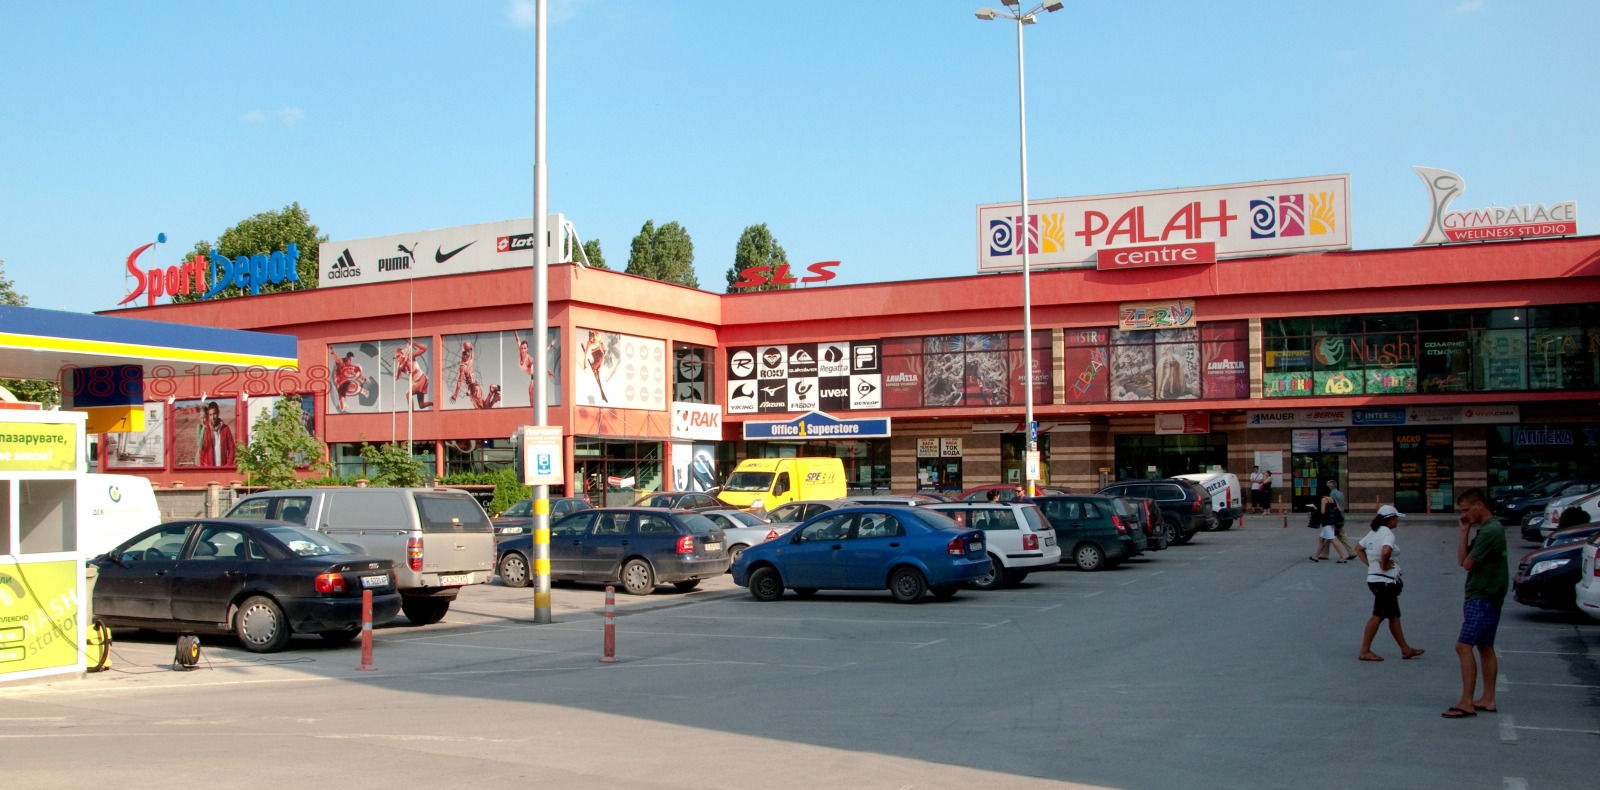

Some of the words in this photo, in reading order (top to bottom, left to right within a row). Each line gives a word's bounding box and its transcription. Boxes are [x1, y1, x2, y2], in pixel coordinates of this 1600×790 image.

[1443, 204, 1574, 228] GYMPALACE
[1454, 227, 1515, 240] WELLNESS
[1518, 224, 1567, 236] STUDIO
[511, 234, 534, 248] lot
[1113, 246, 1198, 265] centre
[378, 255, 409, 273] PUMA
[328, 266, 361, 280] adidas
[734, 261, 841, 288] SLS
[1070, 331, 1106, 344] BISTRO
[820, 364, 848, 373] Regatta
[1207, 358, 1245, 370] LAVAZZA
[886, 372, 918, 383] LAVAZZA
[820, 387, 848, 398] uvex
[1261, 412, 1294, 421] MAUER
[1313, 411, 1345, 419] BERHEL
[1365, 411, 1405, 419] INTERBILD
[121, 417, 127, 428] 7
[771, 424, 798, 435] Office
[798, 420, 807, 436] 1
[807, 423, 859, 436] Superstore
[1396, 434, 1421, 443] КАСКО
[1516, 429, 1574, 446] АПТЕКА
